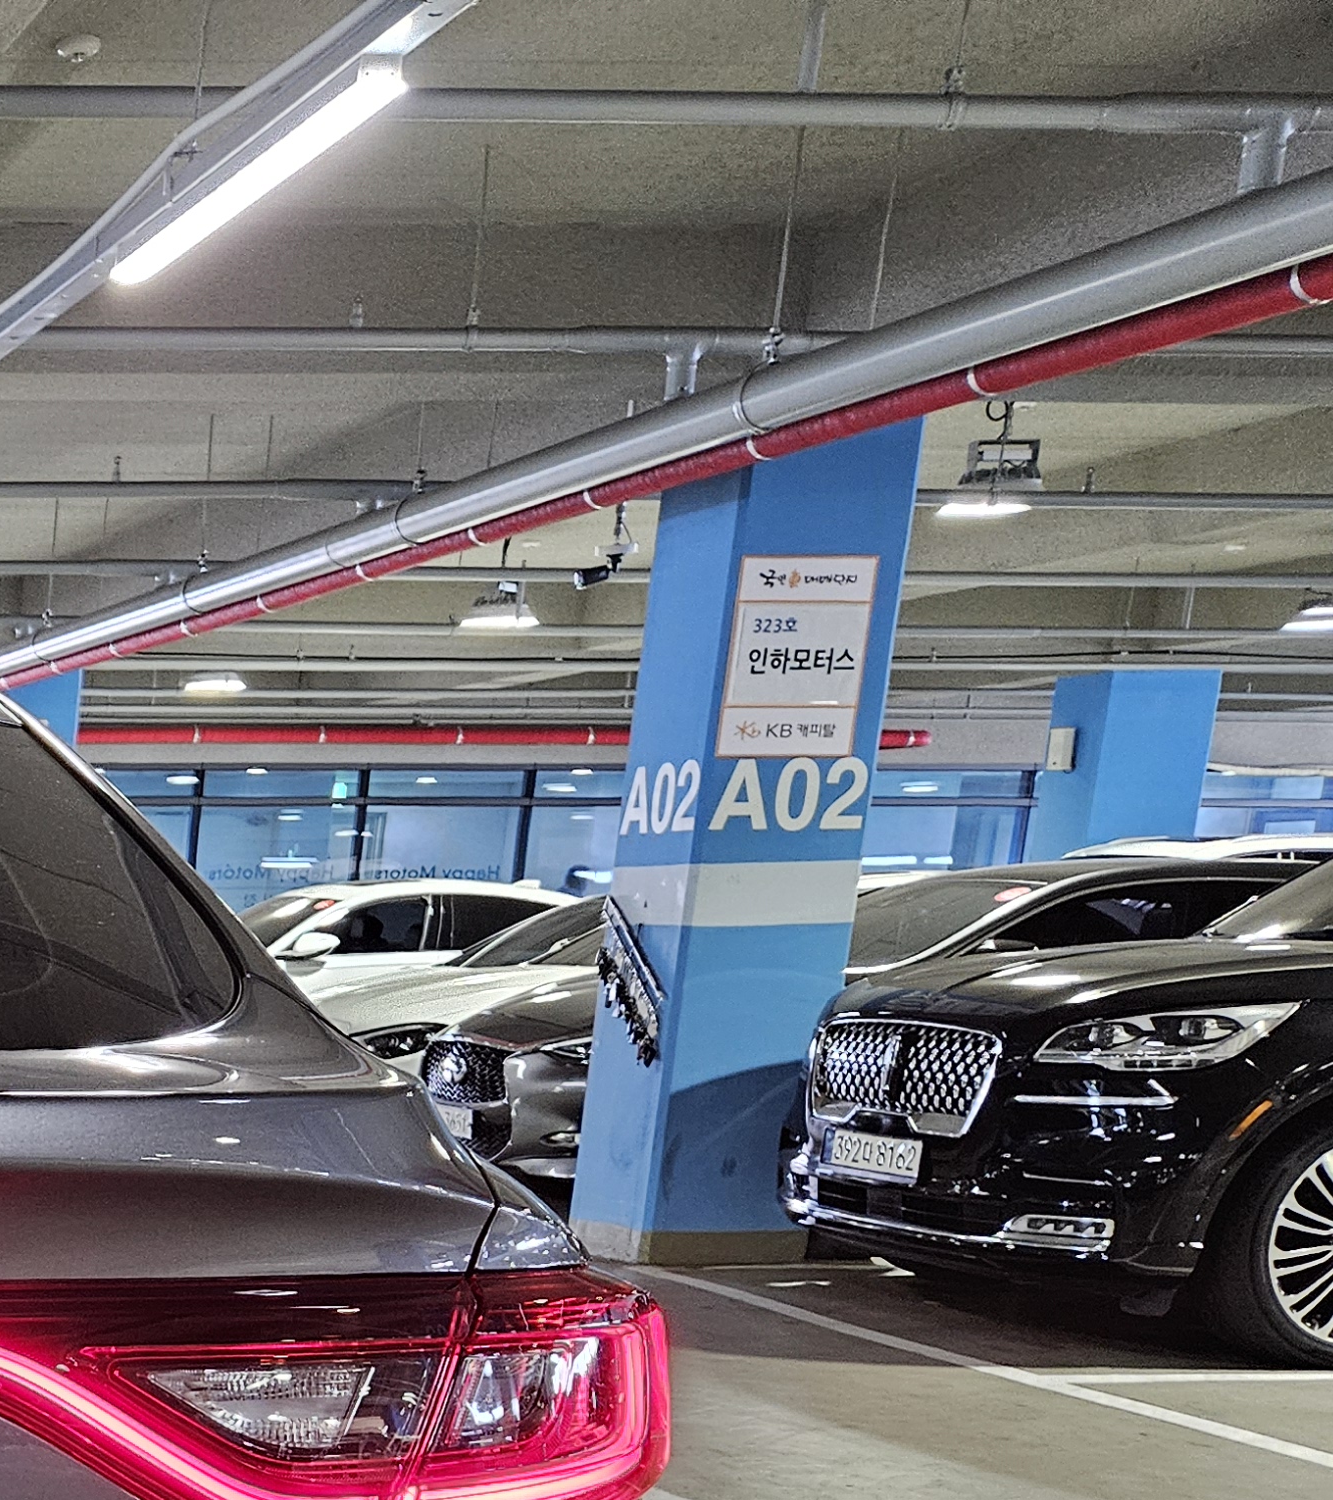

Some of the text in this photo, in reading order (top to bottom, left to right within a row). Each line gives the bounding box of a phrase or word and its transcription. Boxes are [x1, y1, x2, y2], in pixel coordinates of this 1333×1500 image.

[753, 617, 798, 634] 323호
[749, 647, 855, 675] 인하모터스
[765, 723, 836, 738] KB 캐피탈
[620, 759, 701, 836] A02
[708, 756, 869, 832] A02
[876, 1140, 918, 1171] 8162
